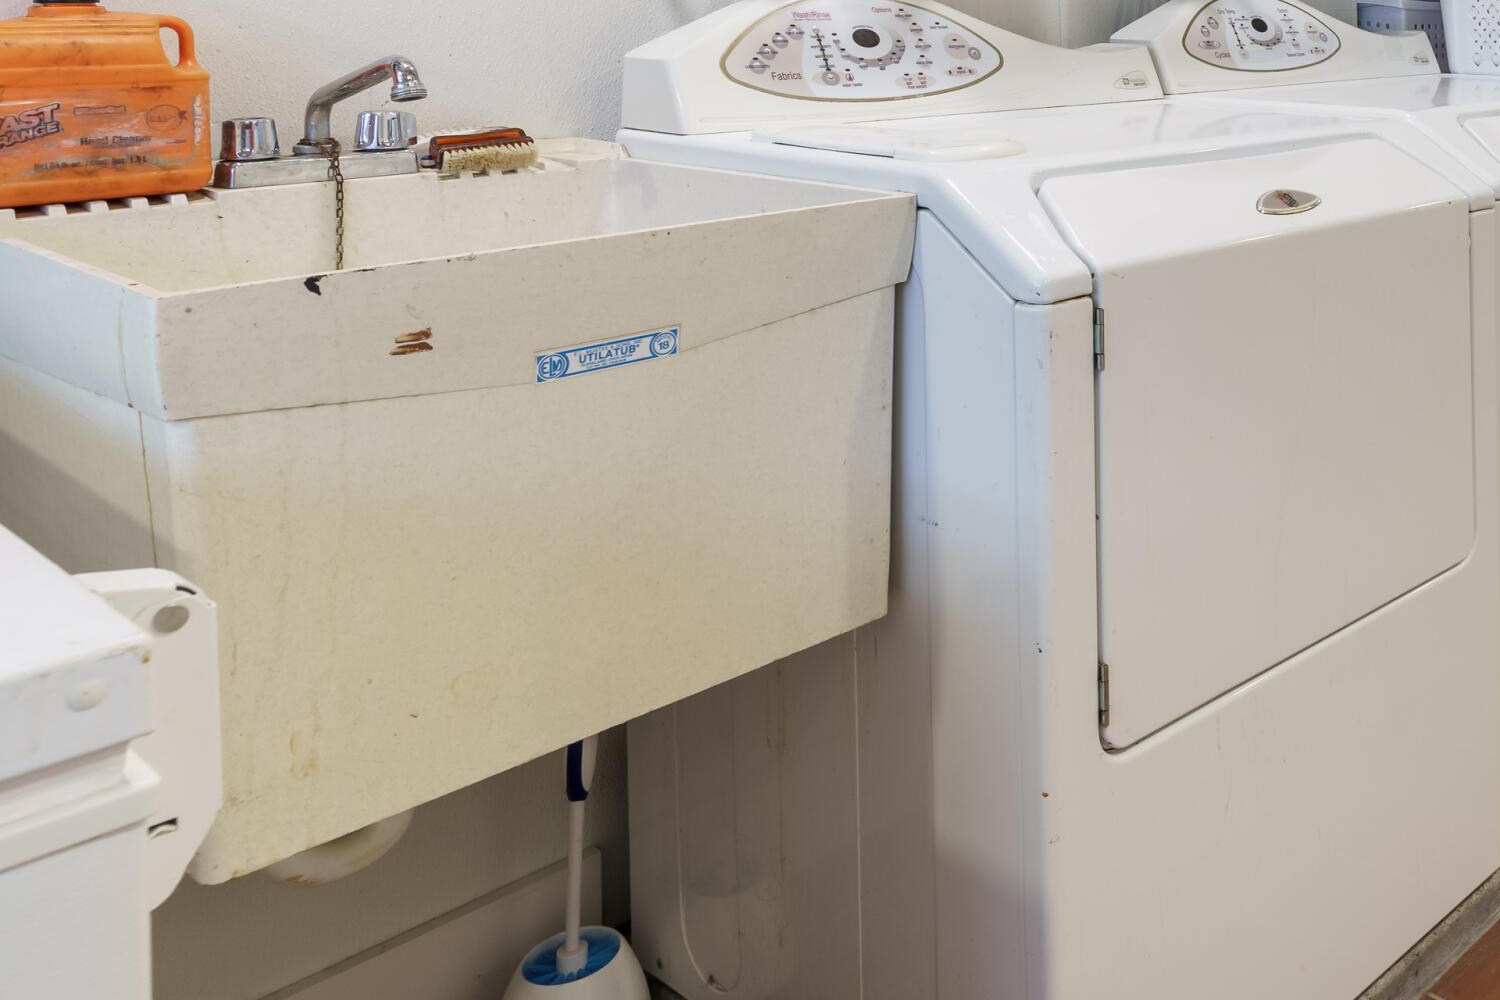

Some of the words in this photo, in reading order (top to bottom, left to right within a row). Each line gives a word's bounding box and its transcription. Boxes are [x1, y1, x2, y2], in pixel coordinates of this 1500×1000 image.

[771, 72, 802, 81] Fabrics
[0, 103, 60, 135] AST
[0, 121, 60, 149] RANGE
[658, 341, 670, 350] 18
